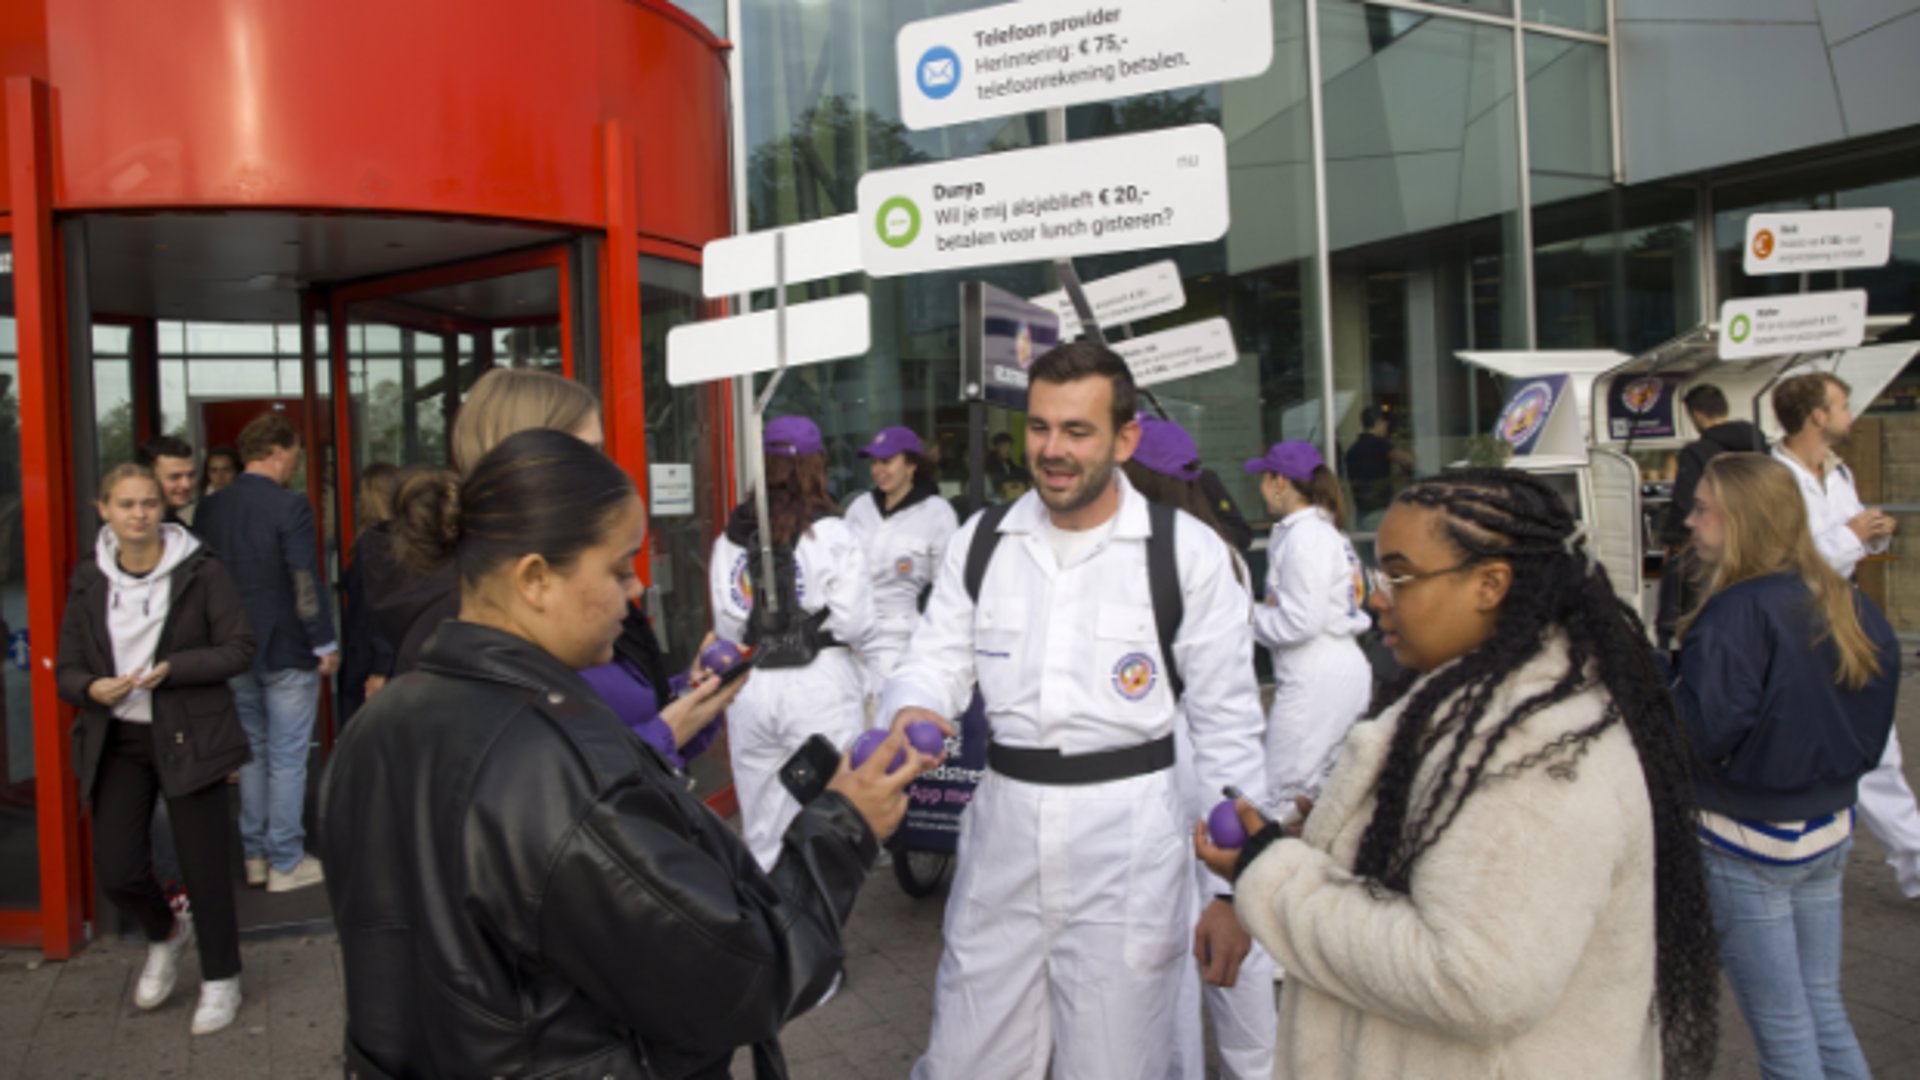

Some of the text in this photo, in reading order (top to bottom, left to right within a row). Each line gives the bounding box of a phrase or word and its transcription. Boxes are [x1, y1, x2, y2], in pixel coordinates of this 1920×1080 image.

[974, 8, 1121, 47] Telefoon provider
[975, 34, 1128, 74] Herinnering: € 75,-
[977, 52, 1190, 99] telefoonrekening betalen.
[933, 181, 985, 200] Dunya
[935, 185, 1150, 226] Wil je mij alsjeblieft € 20,-
[936, 207, 1174, 251] betalen voor lunch gisteren?
